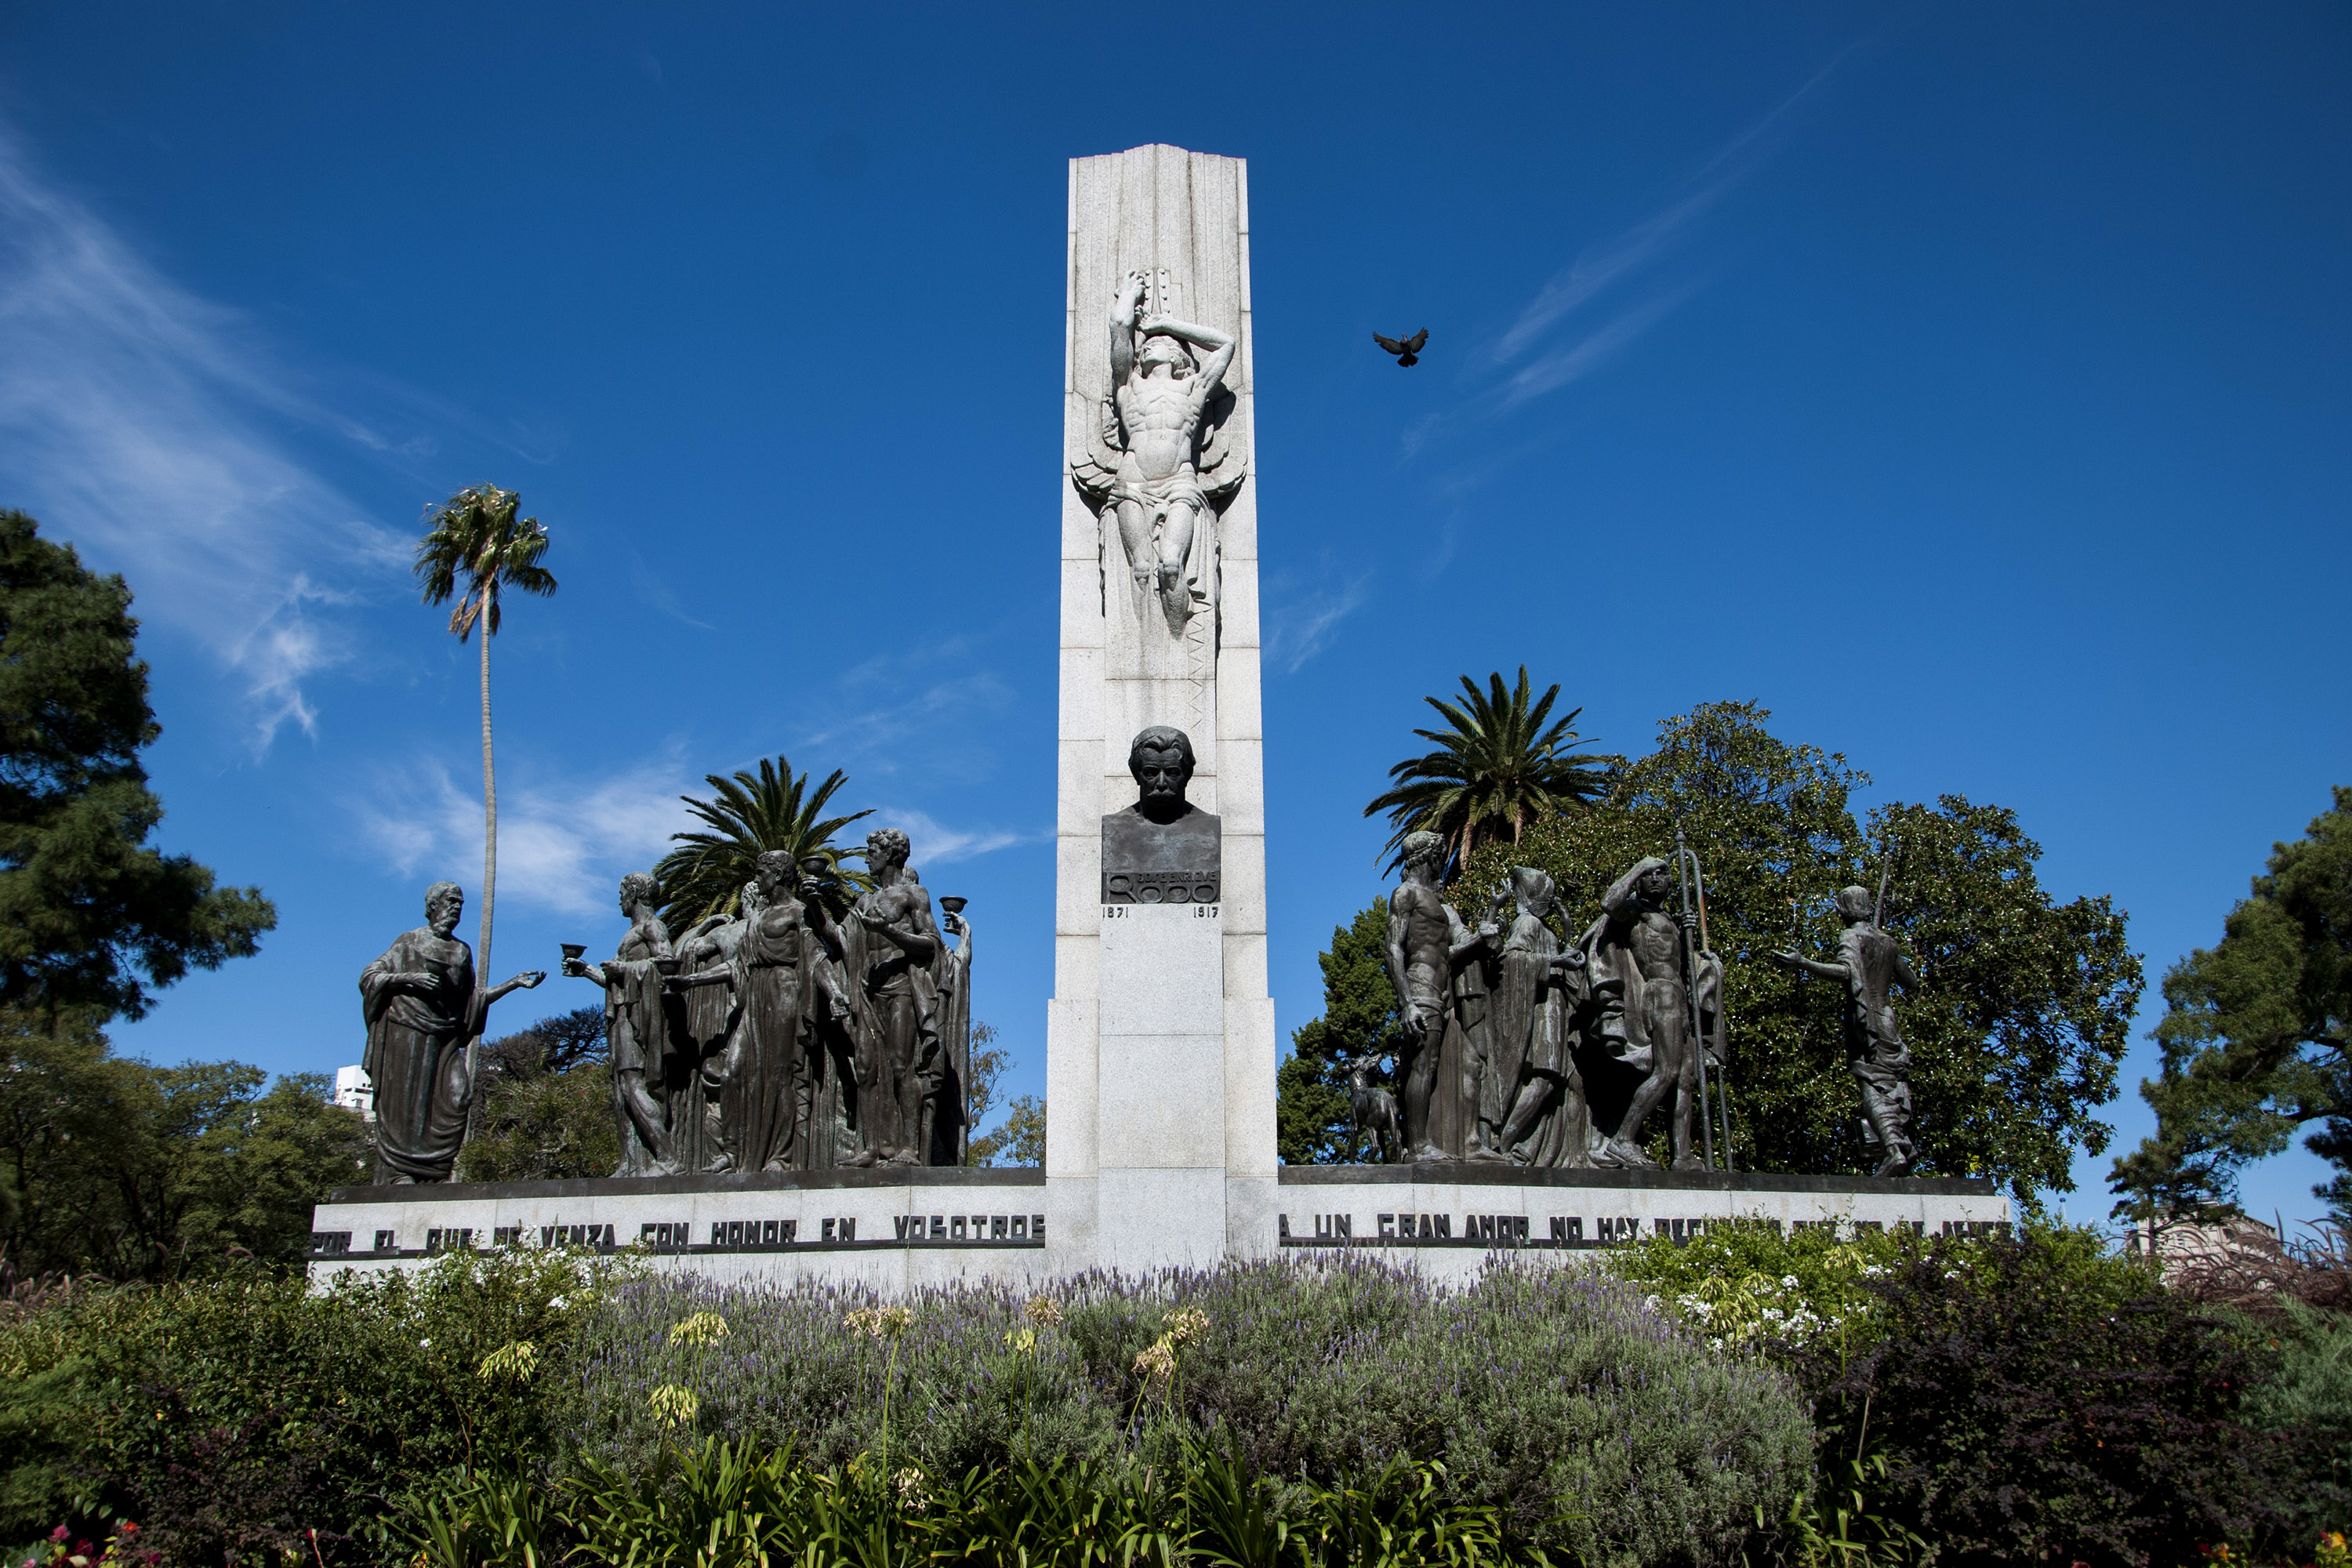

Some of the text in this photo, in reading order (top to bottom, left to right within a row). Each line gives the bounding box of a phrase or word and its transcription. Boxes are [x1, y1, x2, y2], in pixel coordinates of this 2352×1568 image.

[1103, 906, 1218, 918] 1871 1917
[310, 1231, 352, 1253] POR
[375, 1229, 401, 1251] EL
[541, 1224, 615, 1247] VENZA
[641, 1221, 690, 1246] CON
[711, 1219, 797, 1244] HONOR
[821, 1217, 856, 1242] EN
[894, 1214, 1046, 1240] VOSOTROS
[1279, 1213, 1291, 1237] A
[1315, 1213, 1352, 1238] UN
[1377, 1213, 1450, 1238] GRAN
[1465, 1214, 1530, 1240] AMOR
[1549, 1216, 1583, 1240] NO
[1597, 1217, 1640, 1241] HAY
